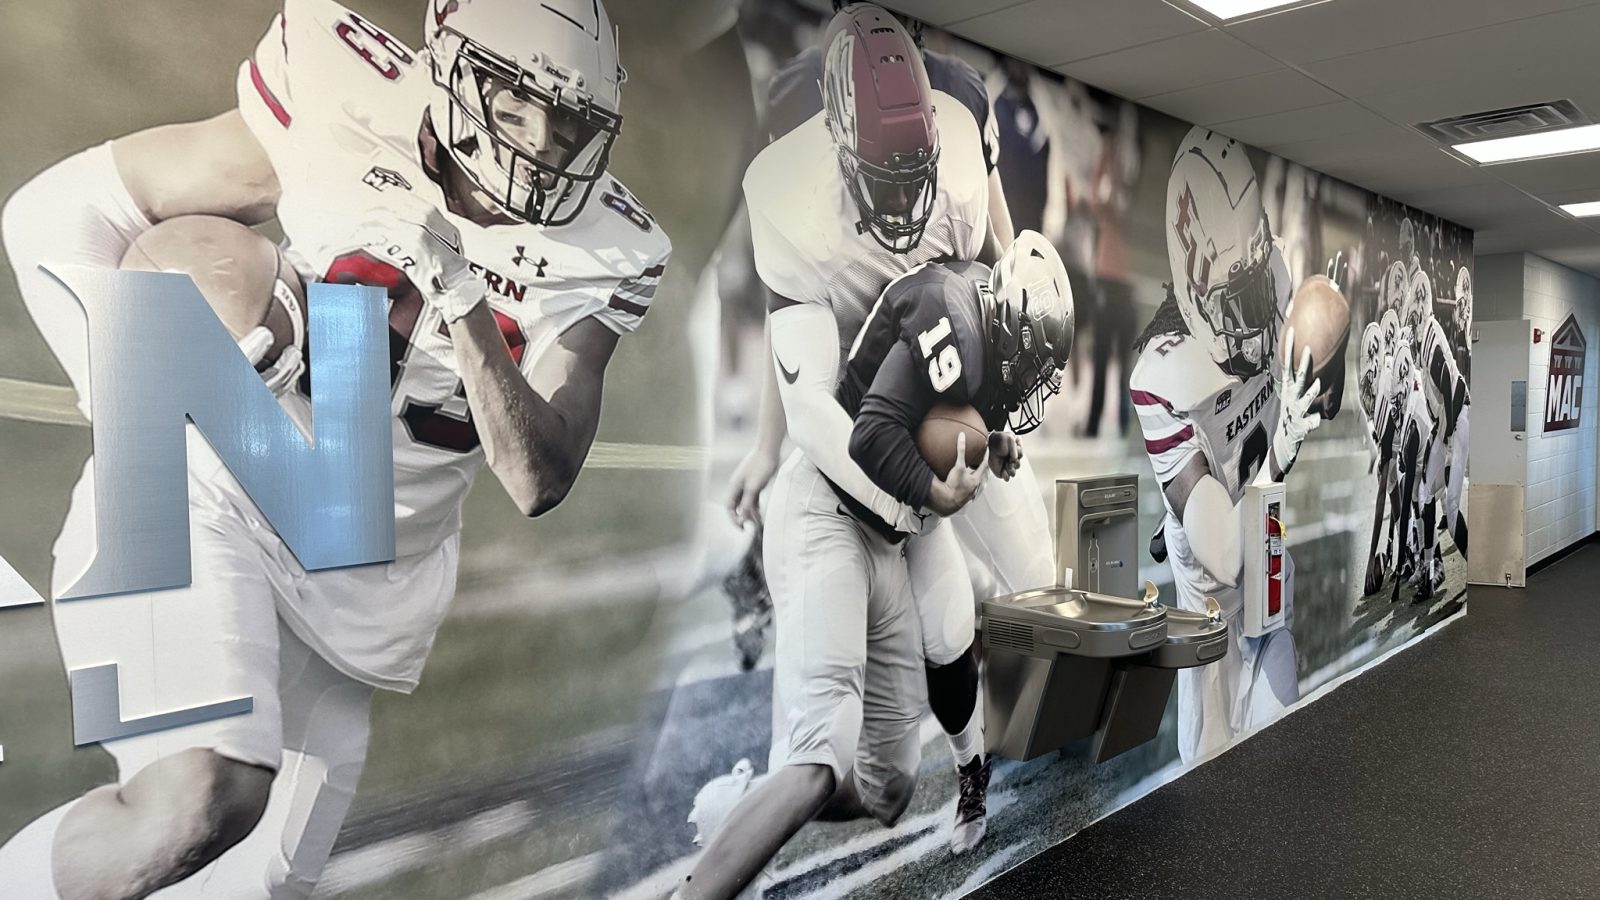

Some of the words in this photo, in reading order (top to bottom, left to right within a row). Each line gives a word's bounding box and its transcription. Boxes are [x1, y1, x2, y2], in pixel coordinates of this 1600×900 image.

[918, 316, 962, 393] 19
[1226, 380, 1275, 444] EASTERN
[1546, 374, 1583, 423] MAC
